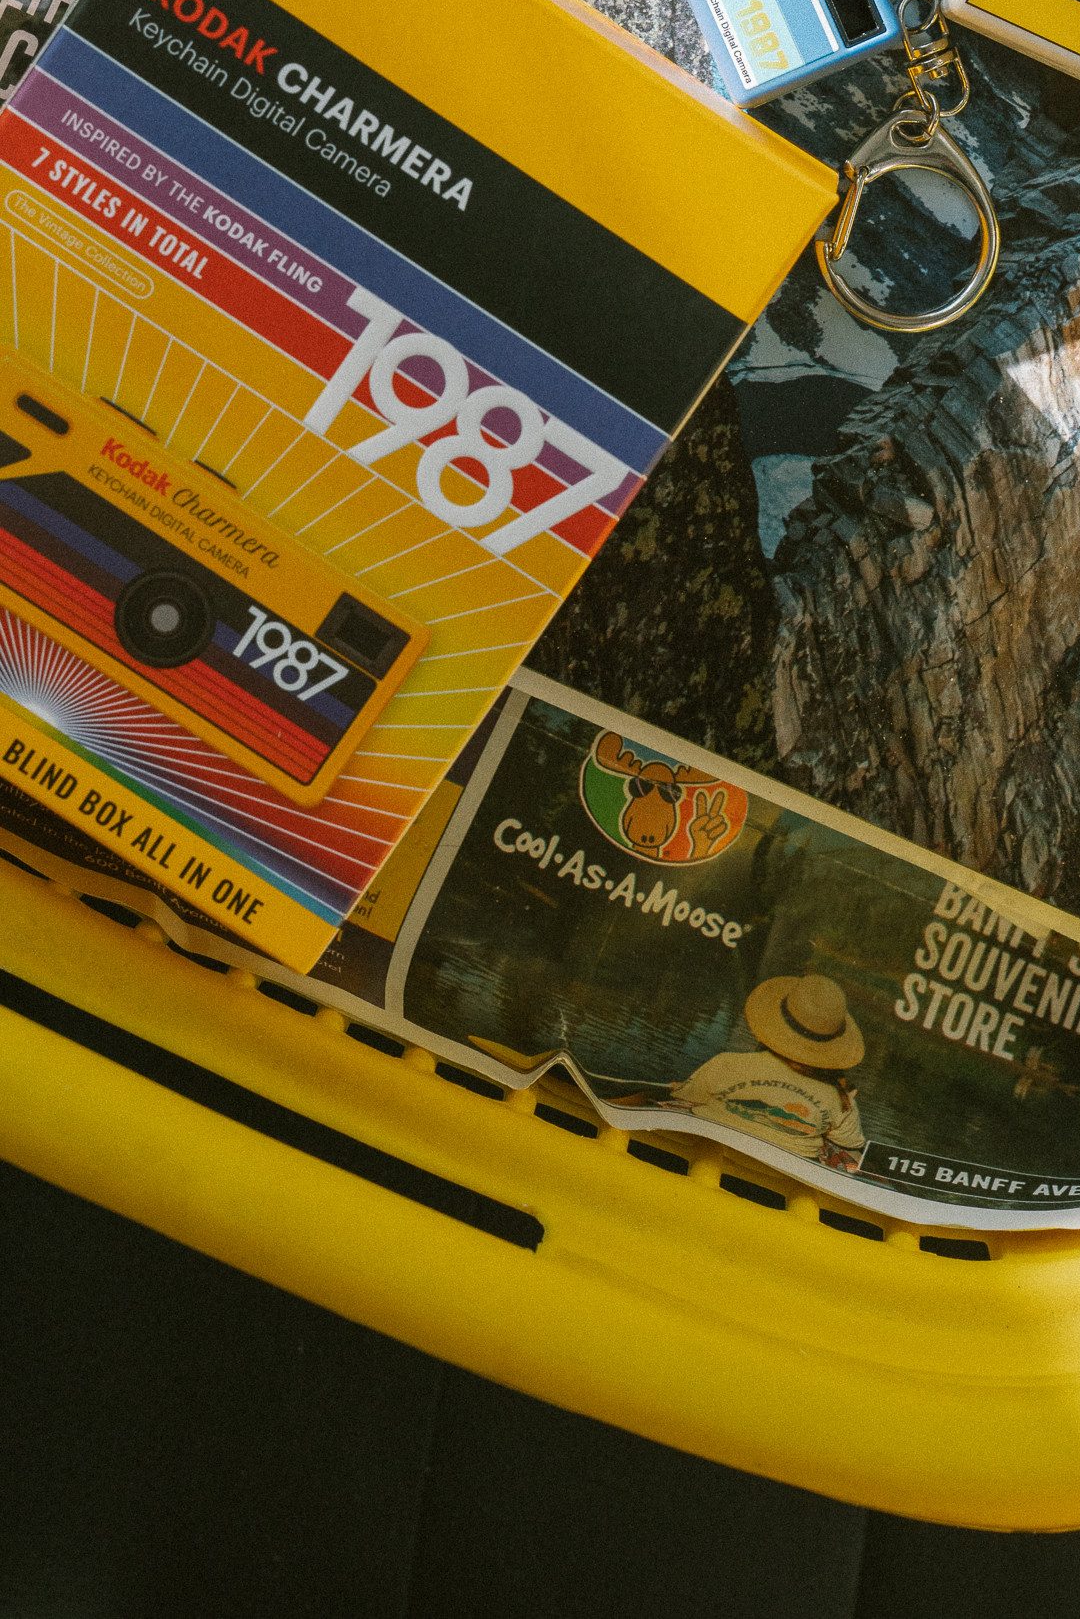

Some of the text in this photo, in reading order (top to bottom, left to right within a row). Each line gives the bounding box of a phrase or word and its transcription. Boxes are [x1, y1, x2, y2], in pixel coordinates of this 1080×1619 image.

[129, 8, 391, 197] Keychain Digital Camera
[720, 17, 738, 49] Digital
[734, 48, 752, 85] Camera
[277, 62, 476, 211] CHARMERA
[14, 195, 148, 292] The Vintage Collection
[31, 148, 210, 280] 7 STYLES IN TOTAL
[61, 109, 323, 293] INSPIRED BY THE KODAK FLING
[304, 285, 632, 559] 1987
[88, 464, 251, 580] KEYCHAIN DIGITAL CAMERA
[100, 437, 281, 570] Kodak Charmera
[231, 605, 350, 702] 1987
[2, 738, 80, 801] BLIND
[78, 787, 137, 839] BOX
[130, 823, 180, 871] ALL
[182, 856, 215, 893] IN
[211, 879, 265, 925] ONE
[84, 854, 119, 872] 600
[895, 974, 1027, 1062] STORE
[887, 1154, 927, 1178] 115
[934, 1166, 1024, 1195] BANFF
